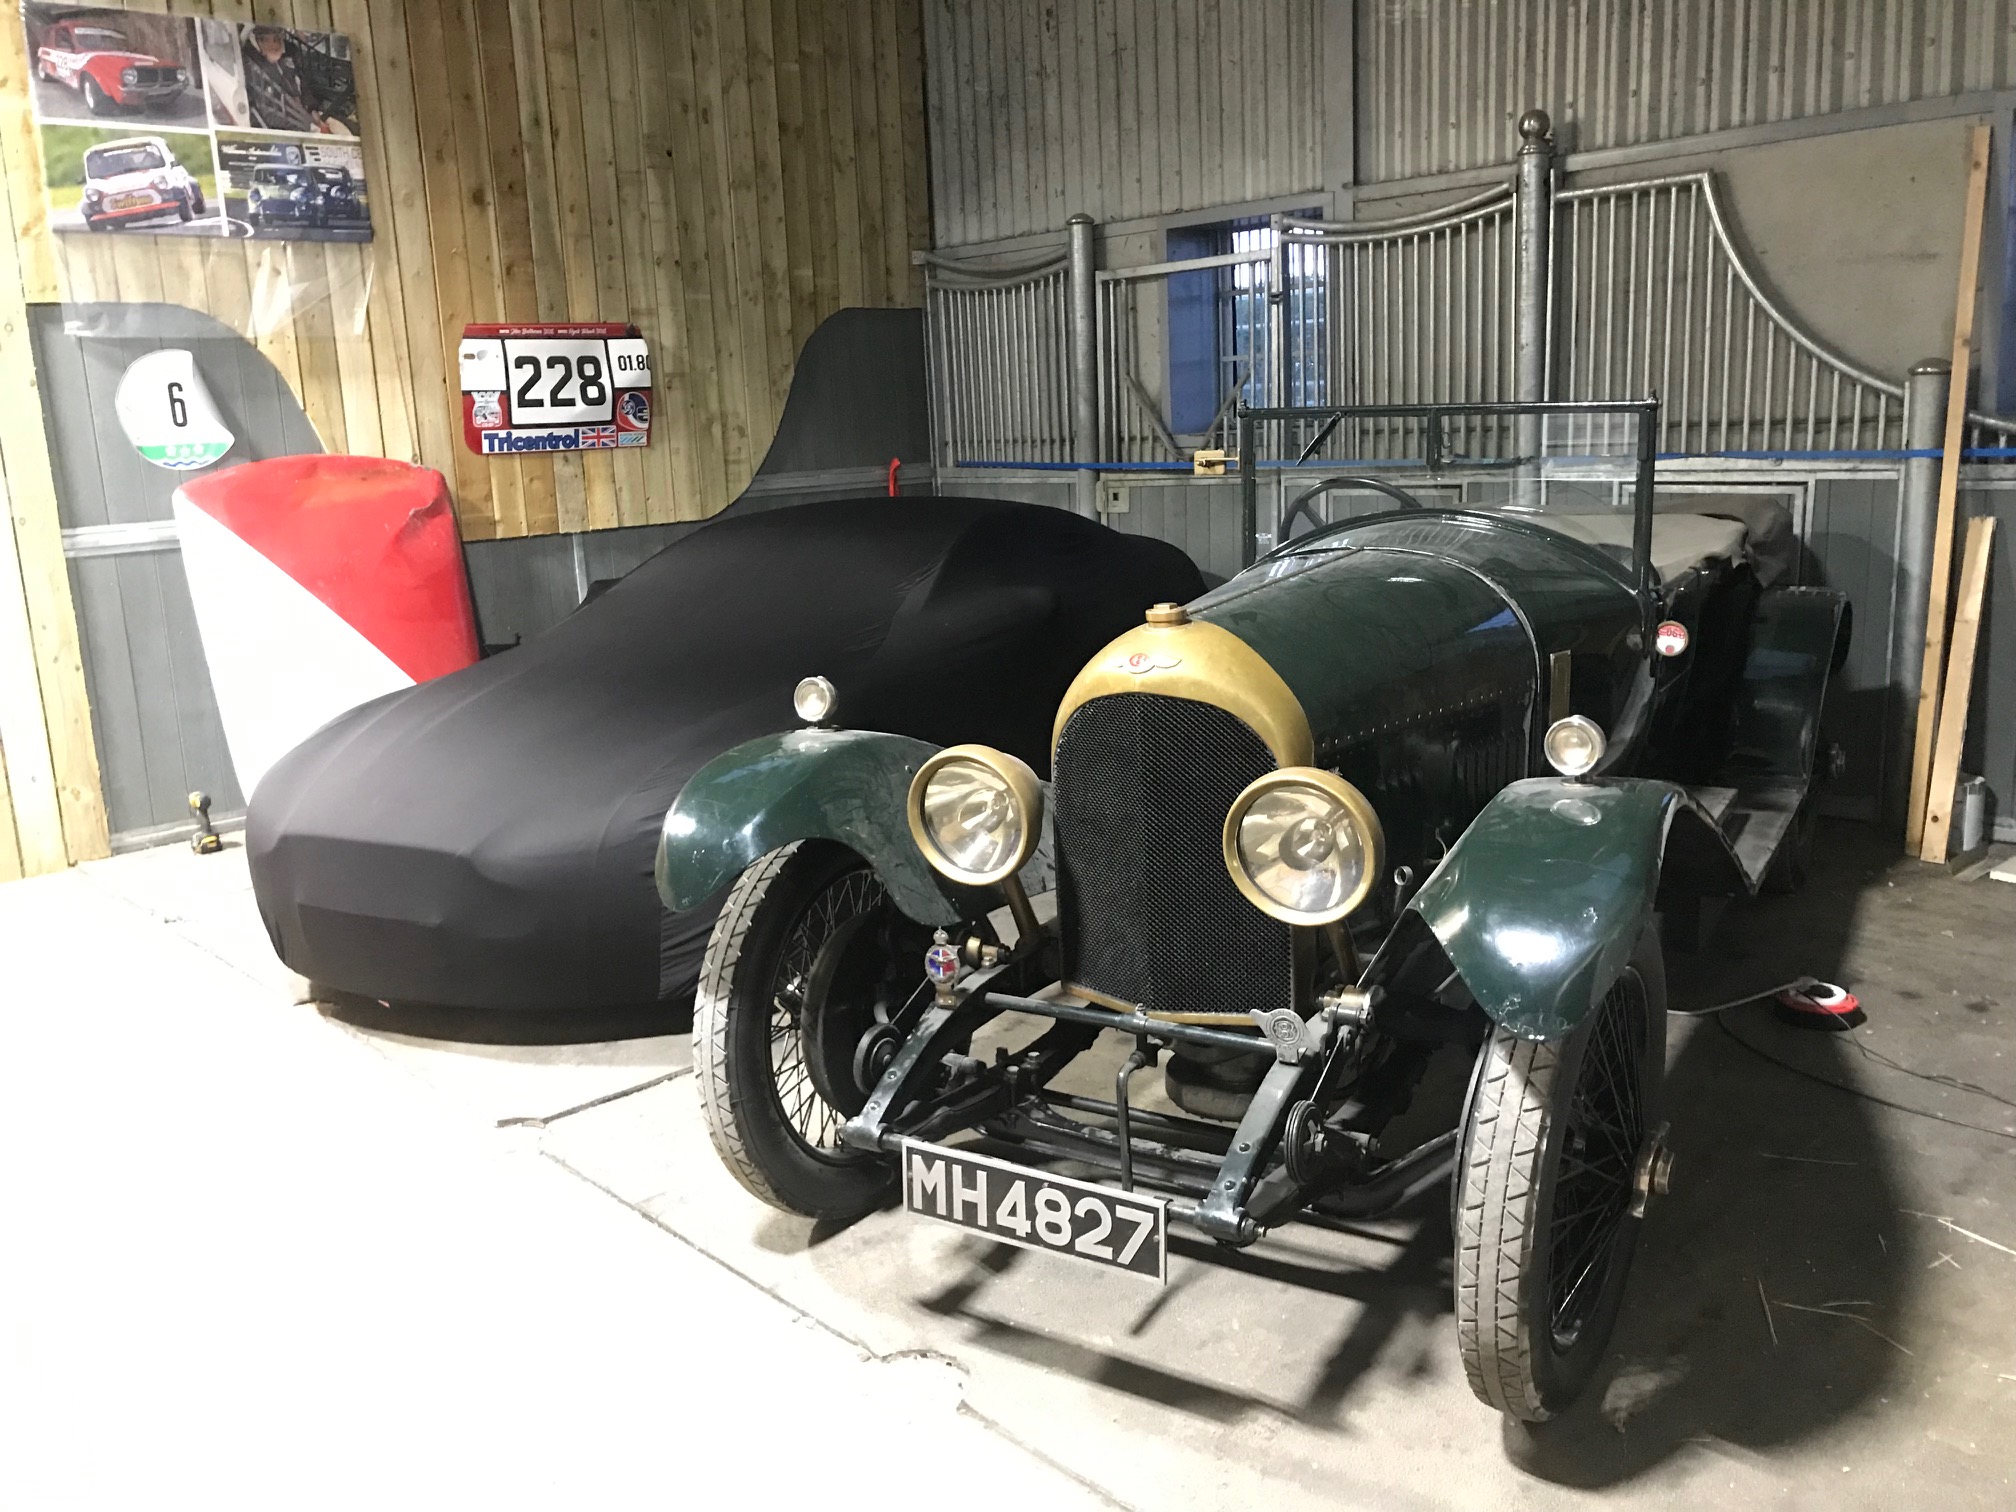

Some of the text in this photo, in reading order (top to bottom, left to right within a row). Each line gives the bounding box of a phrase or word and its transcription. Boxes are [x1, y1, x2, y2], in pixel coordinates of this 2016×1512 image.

[167, 381, 188, 427] 6
[514, 355, 607, 409] 228
[484, 429, 580, 453] Tricentrol
